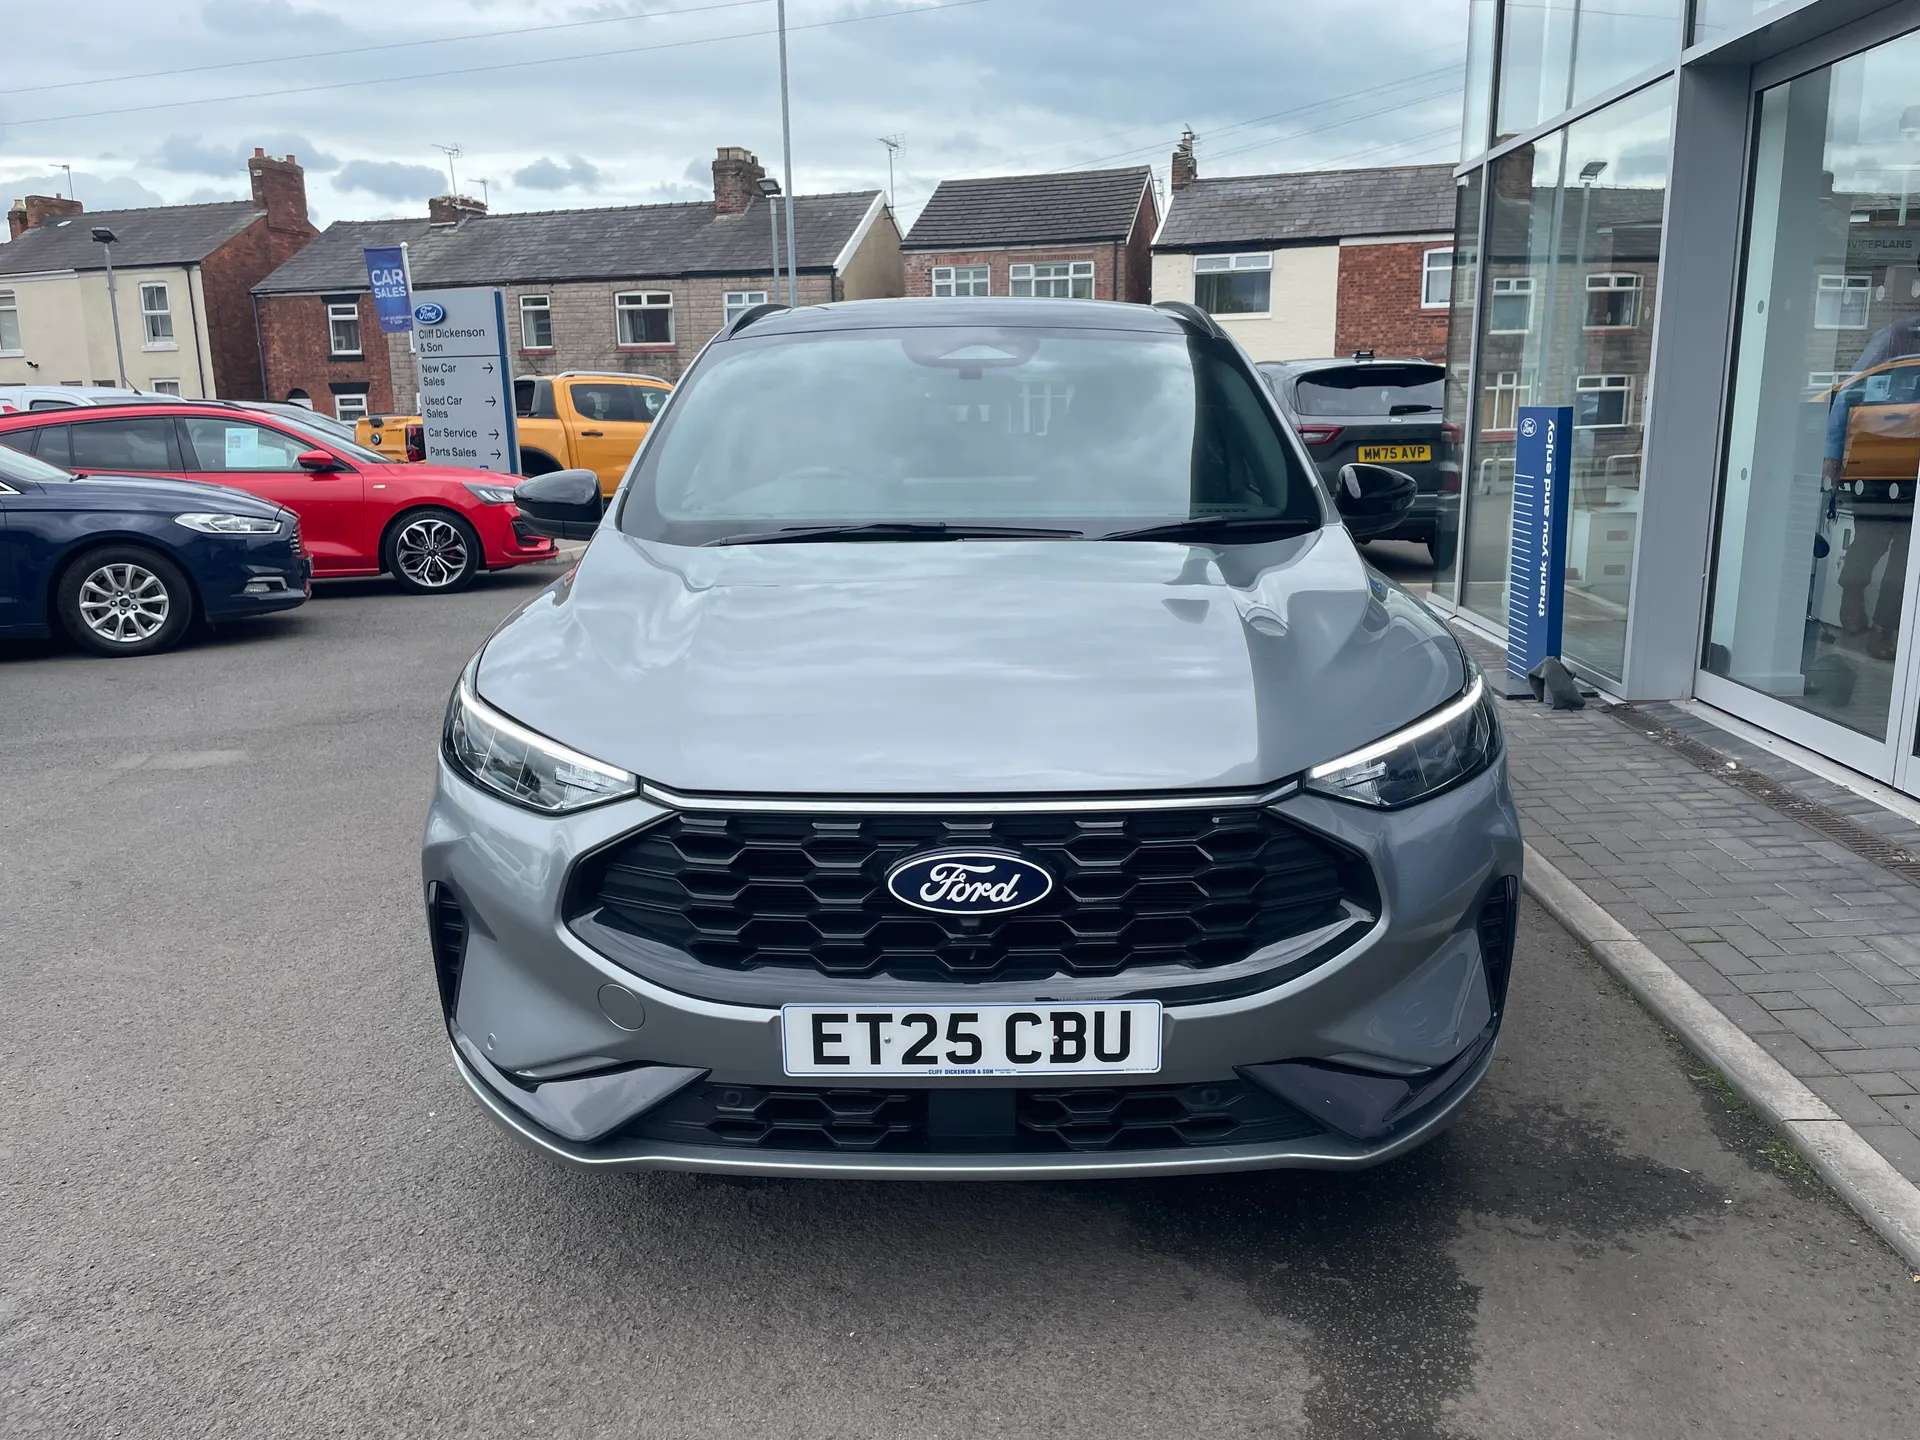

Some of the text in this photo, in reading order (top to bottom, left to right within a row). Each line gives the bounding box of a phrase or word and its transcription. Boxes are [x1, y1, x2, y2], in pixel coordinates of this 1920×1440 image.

[371, 269, 405, 286] CAR
[374, 286, 407, 299] SALES
[418, 306, 437, 320] Ford
[418, 328, 486, 340] Cliff Dickenson
[420, 343, 443, 352] & Son
[421, 363, 457, 373] New Car
[423, 376, 446, 387] Sales
[424, 395, 463, 406] Used Car
[426, 408, 449, 419] Sales
[428, 427, 478, 438] Car Service
[430, 446, 477, 457] Parts Sales
[1364, 446, 1425, 460] MM75 AVP
[1538, 418, 1556, 618] thank you and enjoy
[919, 862, 1021, 902] Ford
[811, 1010, 1131, 1065] ET25 CBU
